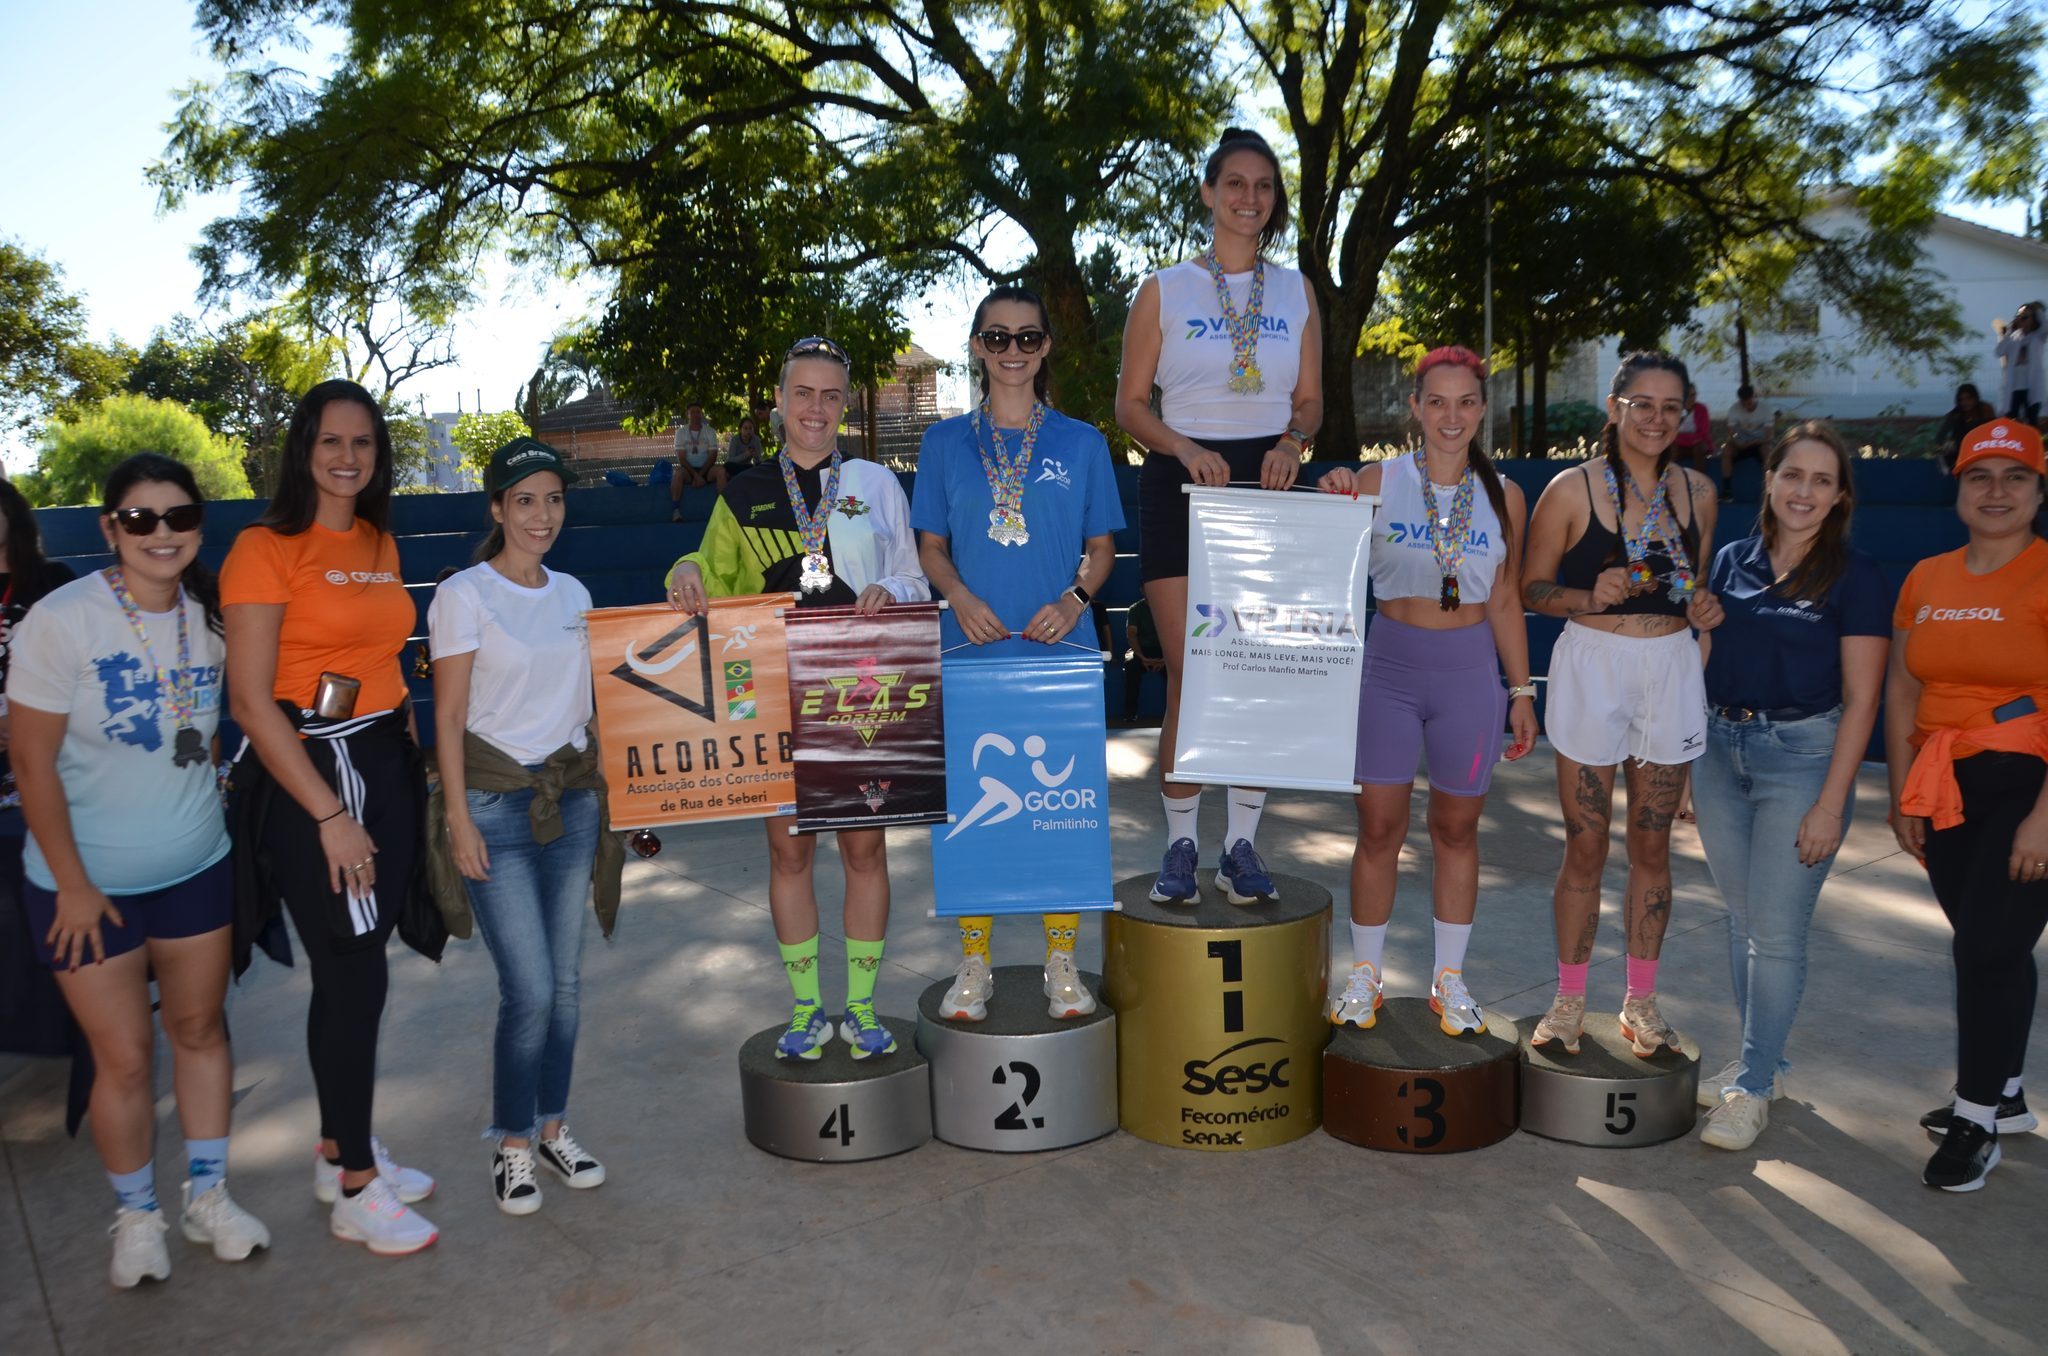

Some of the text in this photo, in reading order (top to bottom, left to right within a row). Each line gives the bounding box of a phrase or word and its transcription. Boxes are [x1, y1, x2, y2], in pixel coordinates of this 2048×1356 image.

[1209, 316, 1289, 334] VRIA
[1973, 440, 2024, 452] CRESOL
[751, 502, 777, 513] SIMONE
[1932, 607, 2005, 622] CRESOL
[1191, 648, 1354, 665] MAIS LONGE, MAIS LEVE, MAIS VOCÊ!
[1223, 662, 1239, 671] Prof
[1241, 663, 1267, 673] Carlos
[1298, 667, 1328, 676] Martins
[800, 683, 931, 715] ELAS
[826, 711, 907, 726] CORREM
[626, 769, 796, 795] Associação dos Corredores
[660, 790, 768, 812] de Rua de Seberi
[1024, 788, 1097, 812] GCOR
[1033, 818, 1098, 831] Palmitinho
[1207, 939, 1244, 1033] 1
[1182, 1056, 1290, 1096] Sesc
[992, 1061, 1045, 1130] 2
[1181, 1103, 1290, 1125] Fecomércio
[1396, 1077, 1446, 1148] 3
[1604, 1092, 1637, 1136] 5
[819, 1103, 855, 1147] 4
[1182, 1129, 1244, 1146] Senac
